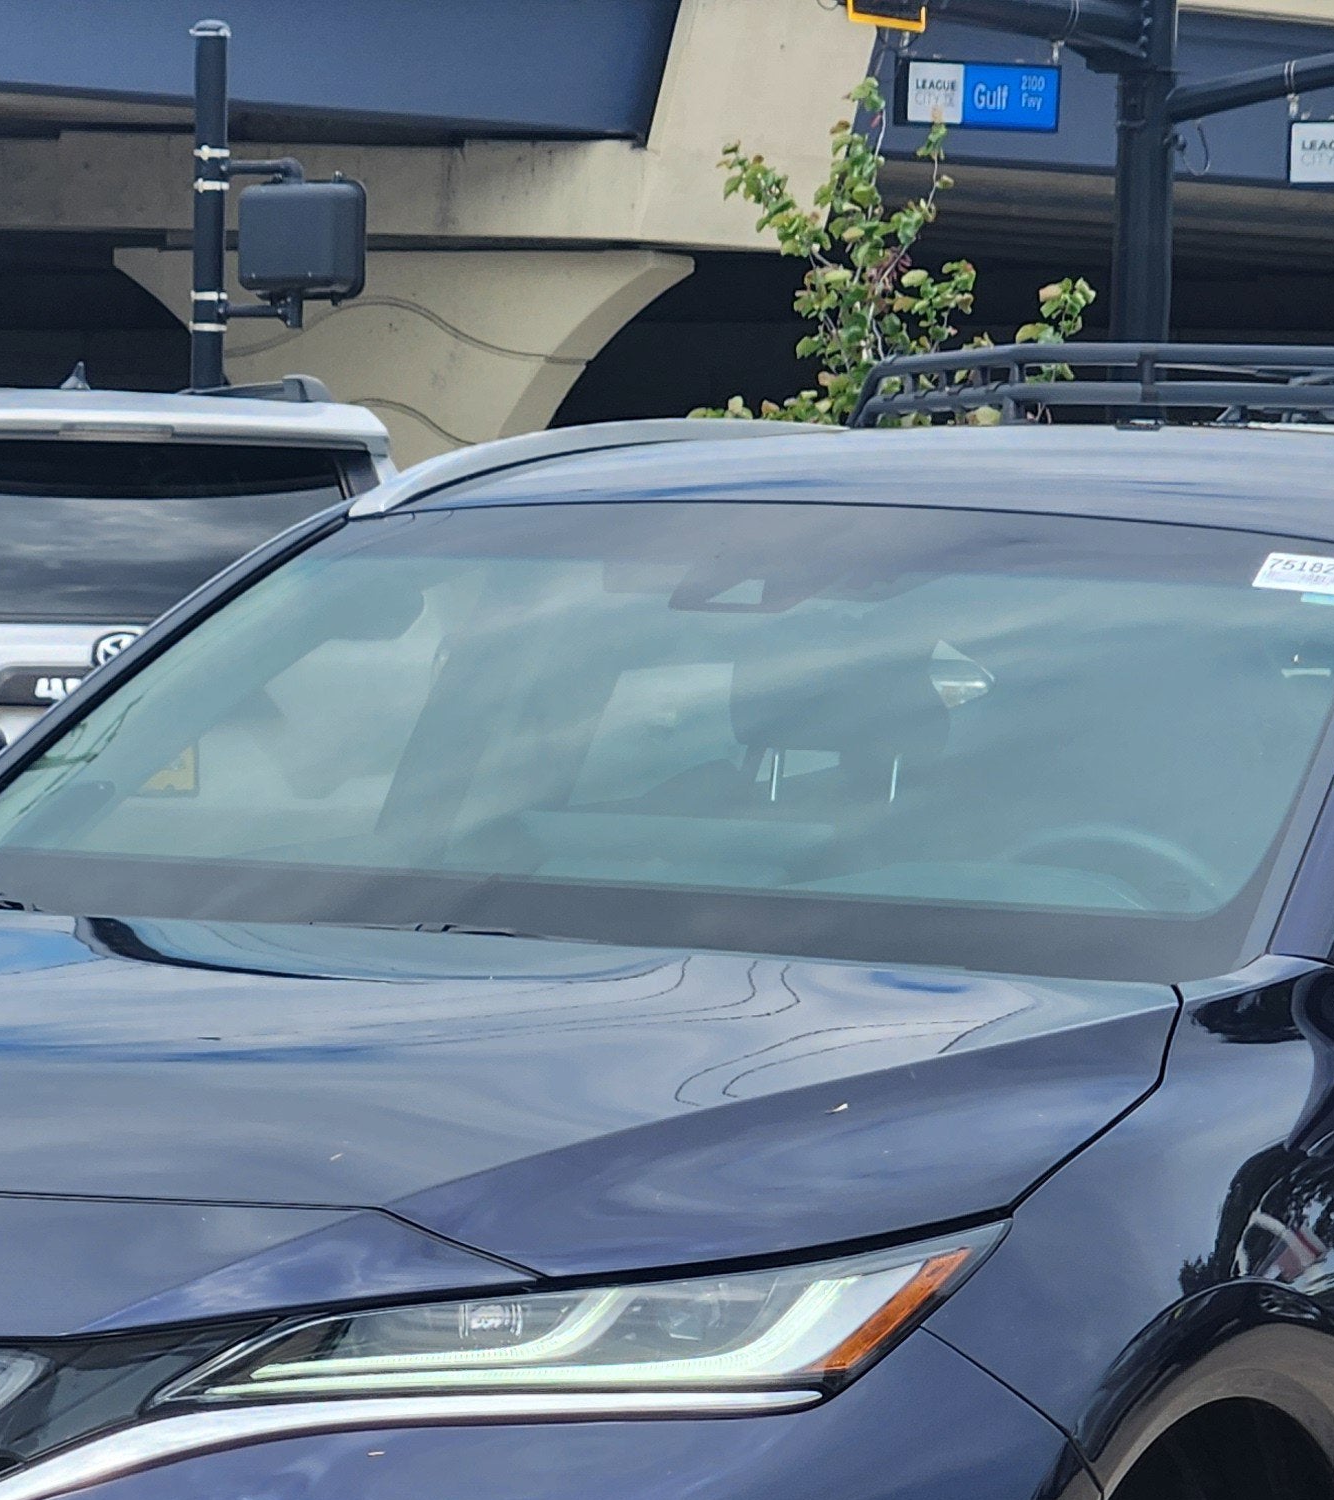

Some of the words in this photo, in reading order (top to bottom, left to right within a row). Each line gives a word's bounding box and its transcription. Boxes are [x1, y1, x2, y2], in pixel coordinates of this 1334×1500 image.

[1021, 75, 1045, 92] 2100
[973, 82, 1009, 111] Gulf
[1021, 93, 1043, 111] Fwy
